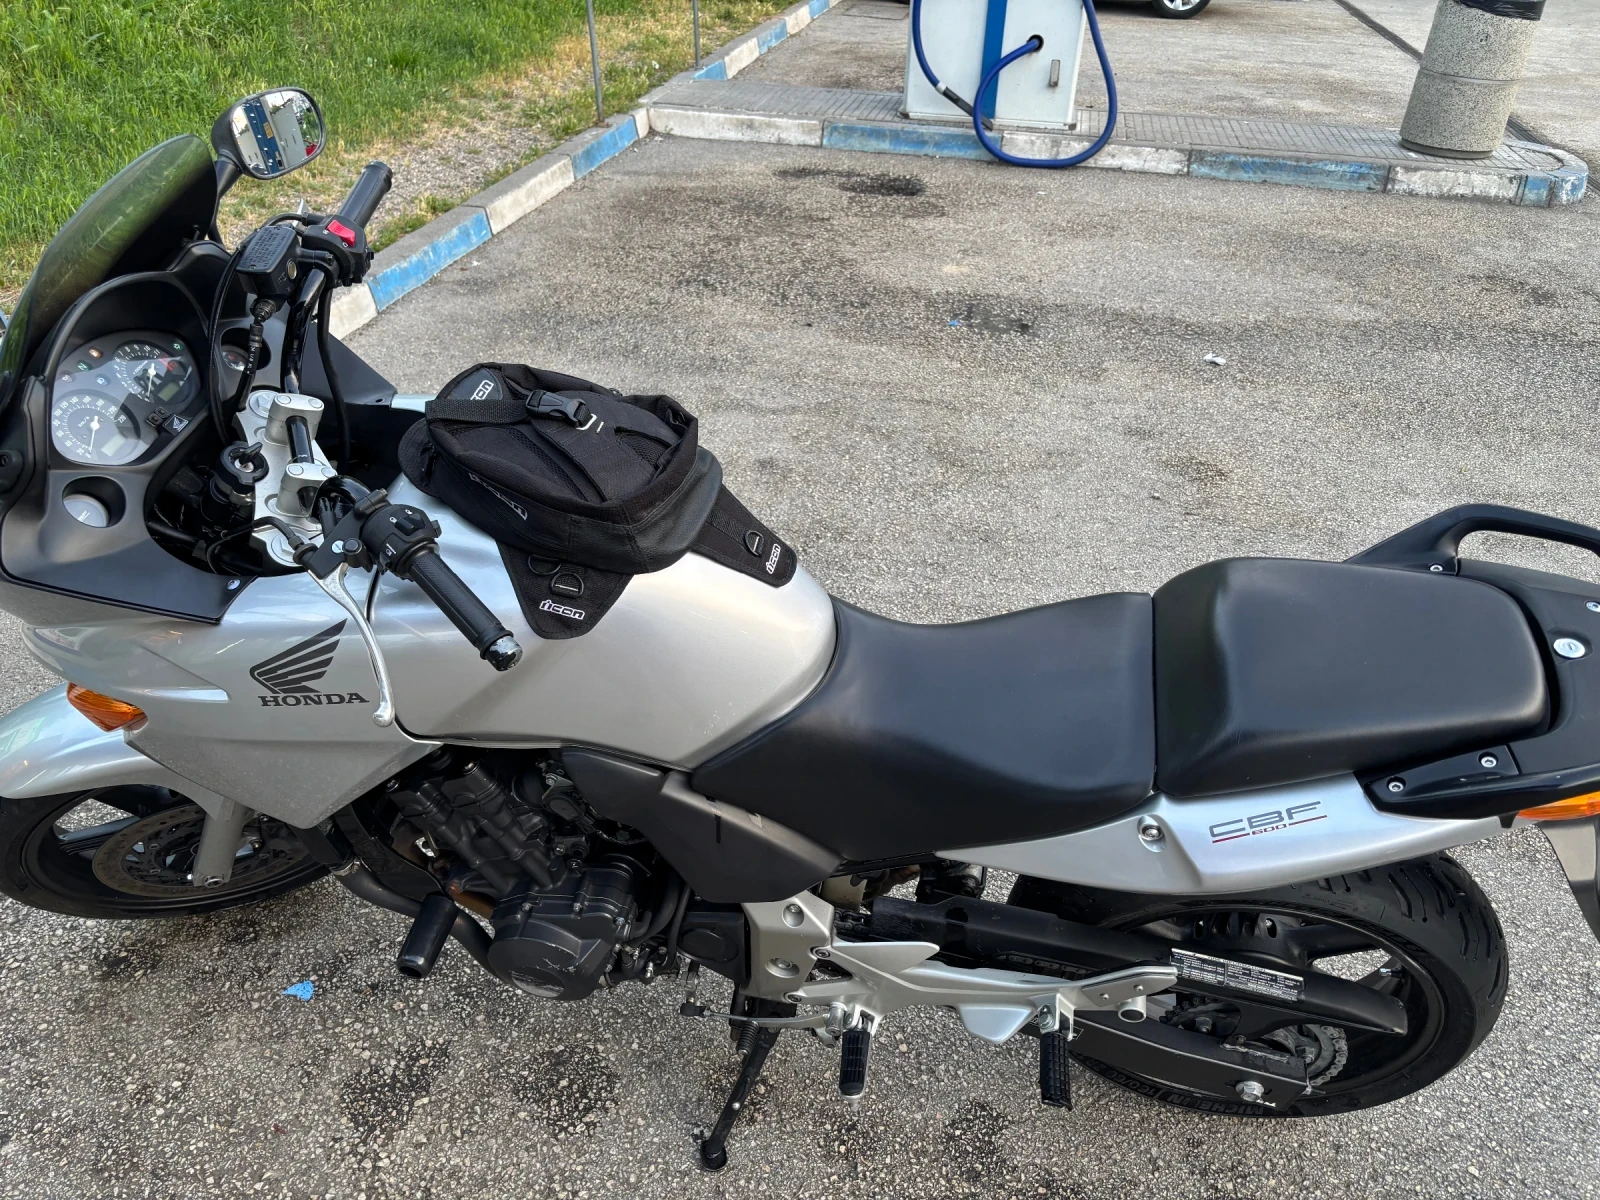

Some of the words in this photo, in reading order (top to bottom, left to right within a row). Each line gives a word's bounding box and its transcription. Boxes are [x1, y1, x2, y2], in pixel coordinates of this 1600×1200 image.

[539, 599, 585, 620] icon
[257, 692, 370, 707] HONDA
[1208, 801, 1321, 838] CBF
[1251, 823, 1288, 835] 600
[1168, 1093, 1264, 1115] MICHELIN
